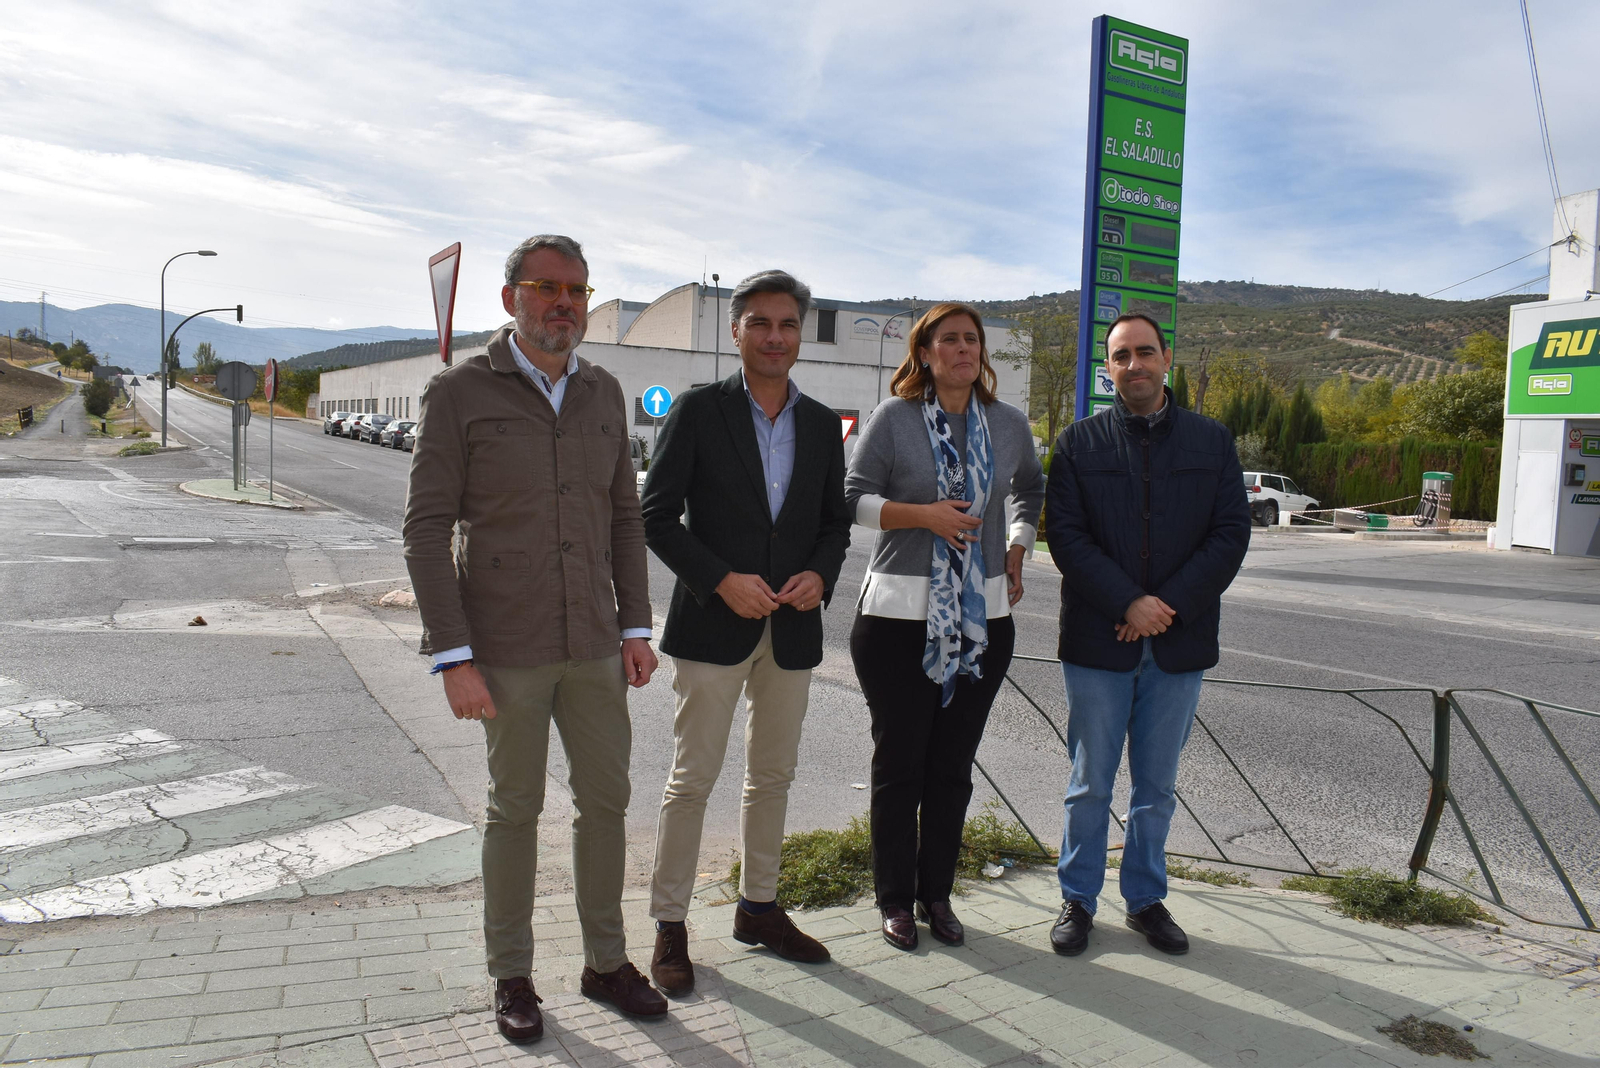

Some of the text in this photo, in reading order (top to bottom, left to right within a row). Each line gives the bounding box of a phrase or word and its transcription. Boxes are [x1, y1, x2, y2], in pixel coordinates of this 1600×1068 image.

[1107, 71, 1136, 88] Gasolineras
[1137, 80, 1153, 92] Libres
[1153, 85, 1160, 94] de
[1134, 118, 1155, 139] E.S.
[1104, 136, 1181, 170] EL SALADILLO
[1152, 195, 1180, 216] Shop
[1104, 234, 1110, 242] A
[1101, 271, 1111, 281] 95
[1100, 310, 1106, 318] A
[1543, 328, 1600, 358] AU
